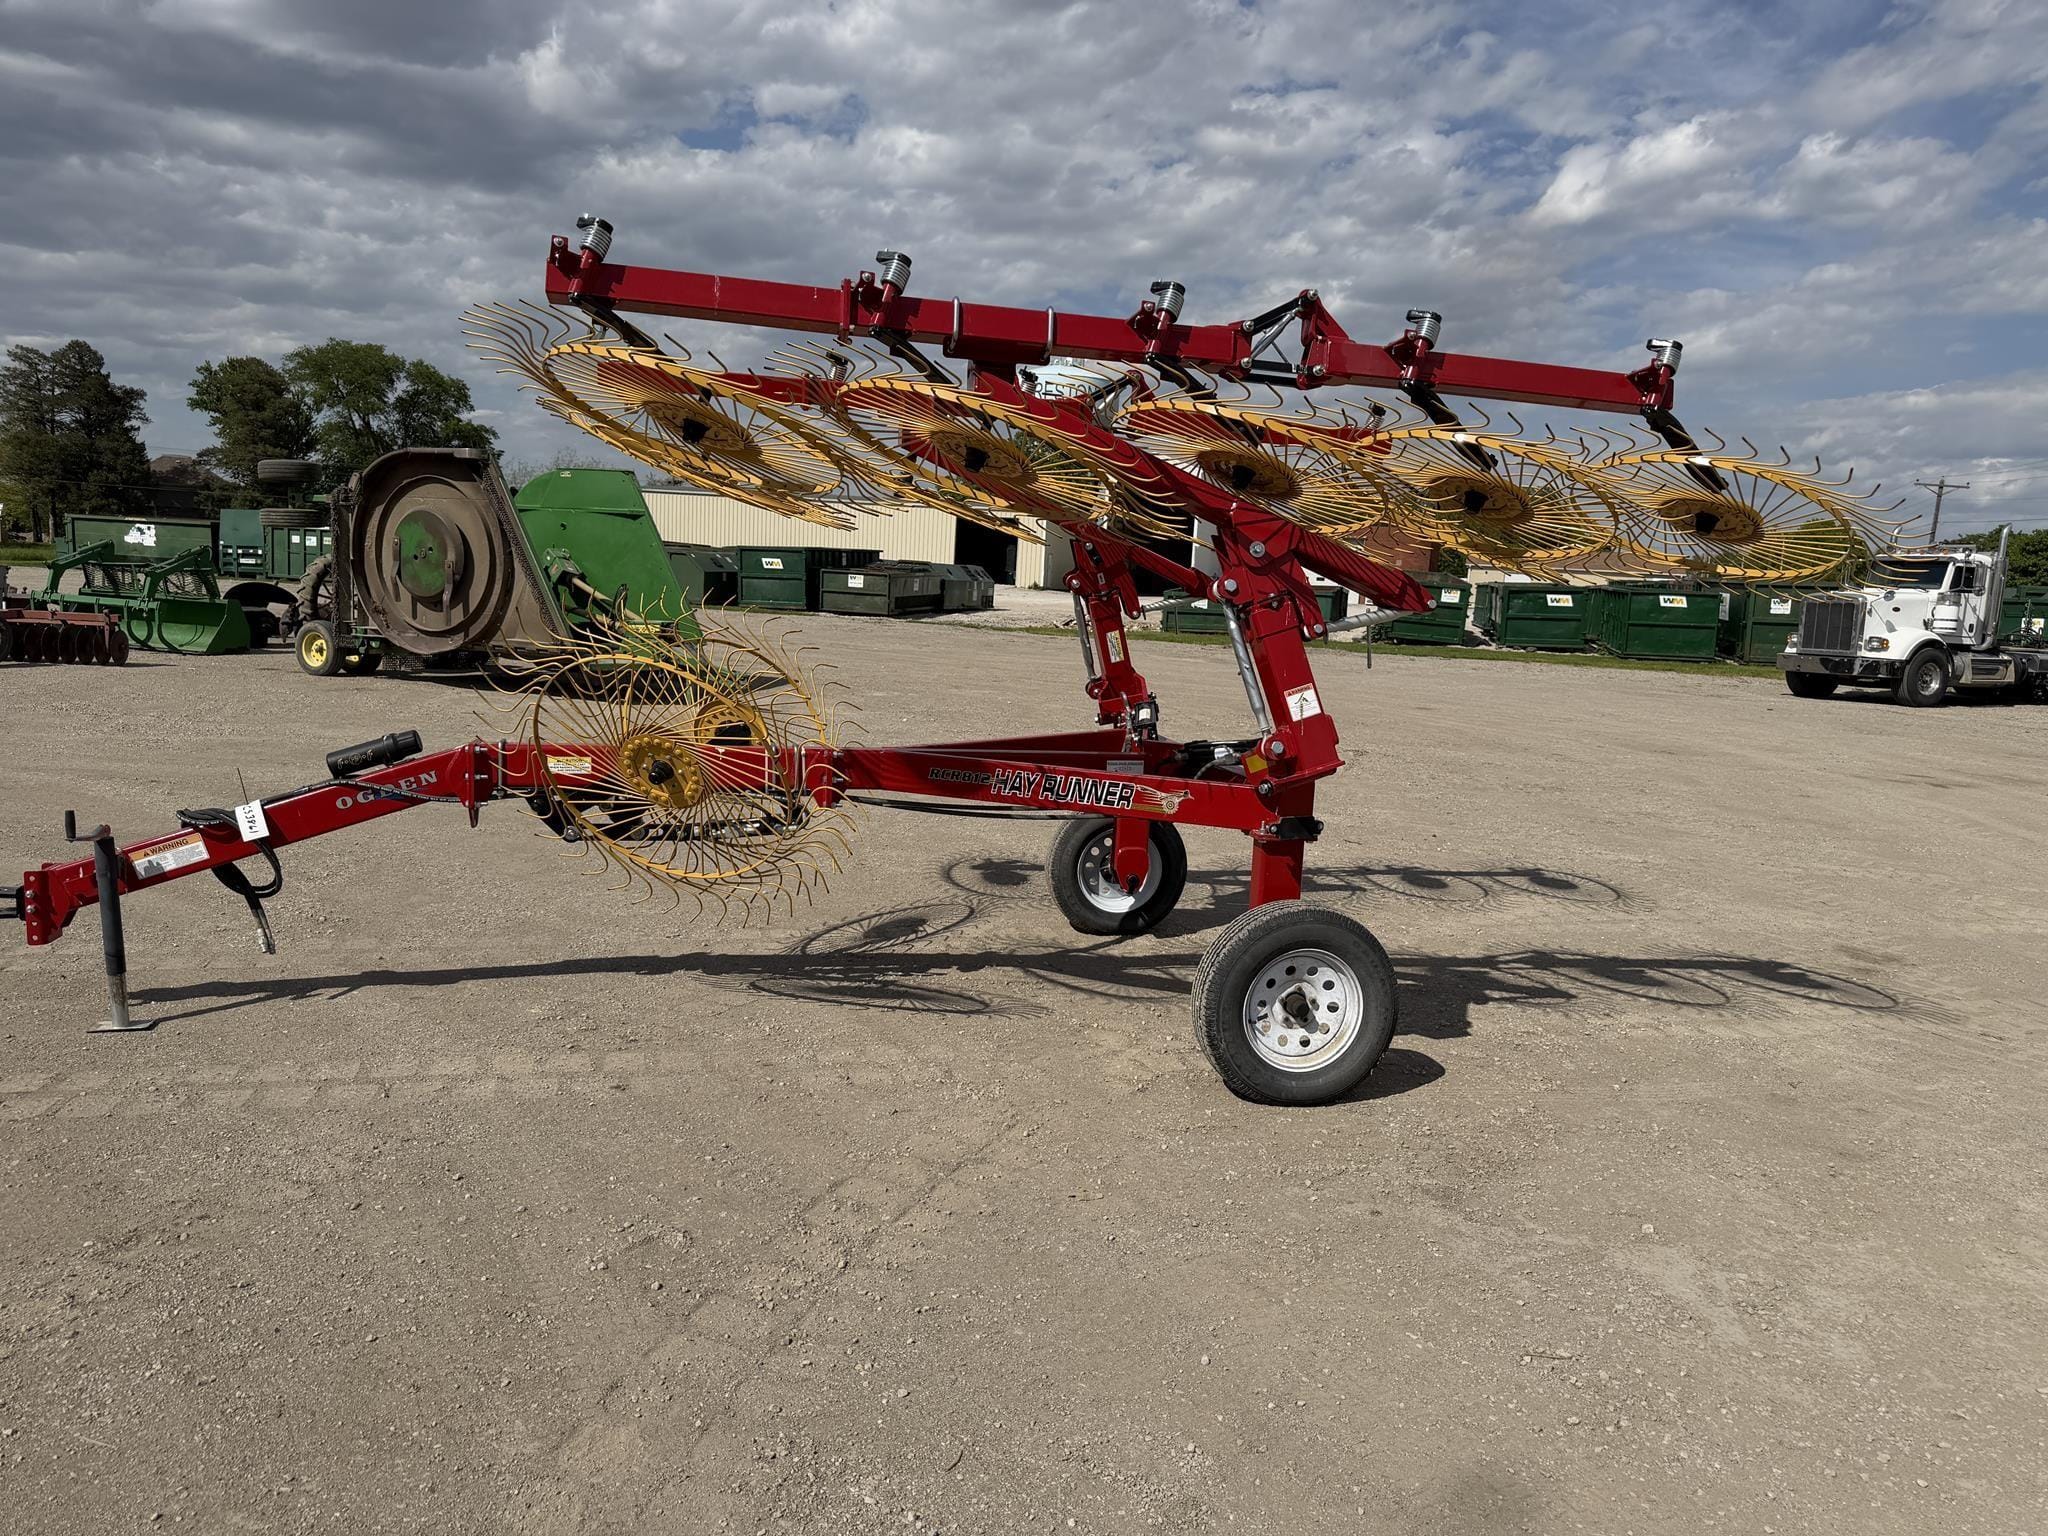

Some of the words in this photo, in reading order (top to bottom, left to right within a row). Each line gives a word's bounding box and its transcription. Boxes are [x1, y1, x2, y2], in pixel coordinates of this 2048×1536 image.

[764, 560, 782, 568] WM
[1663, 597, 1685, 605] WM
[336, 770, 438, 809] OGDEN
[991, 768, 1041, 798] HAY
[1039, 773, 1136, 810] RUNNER
[149, 838, 189, 856] WARNING
